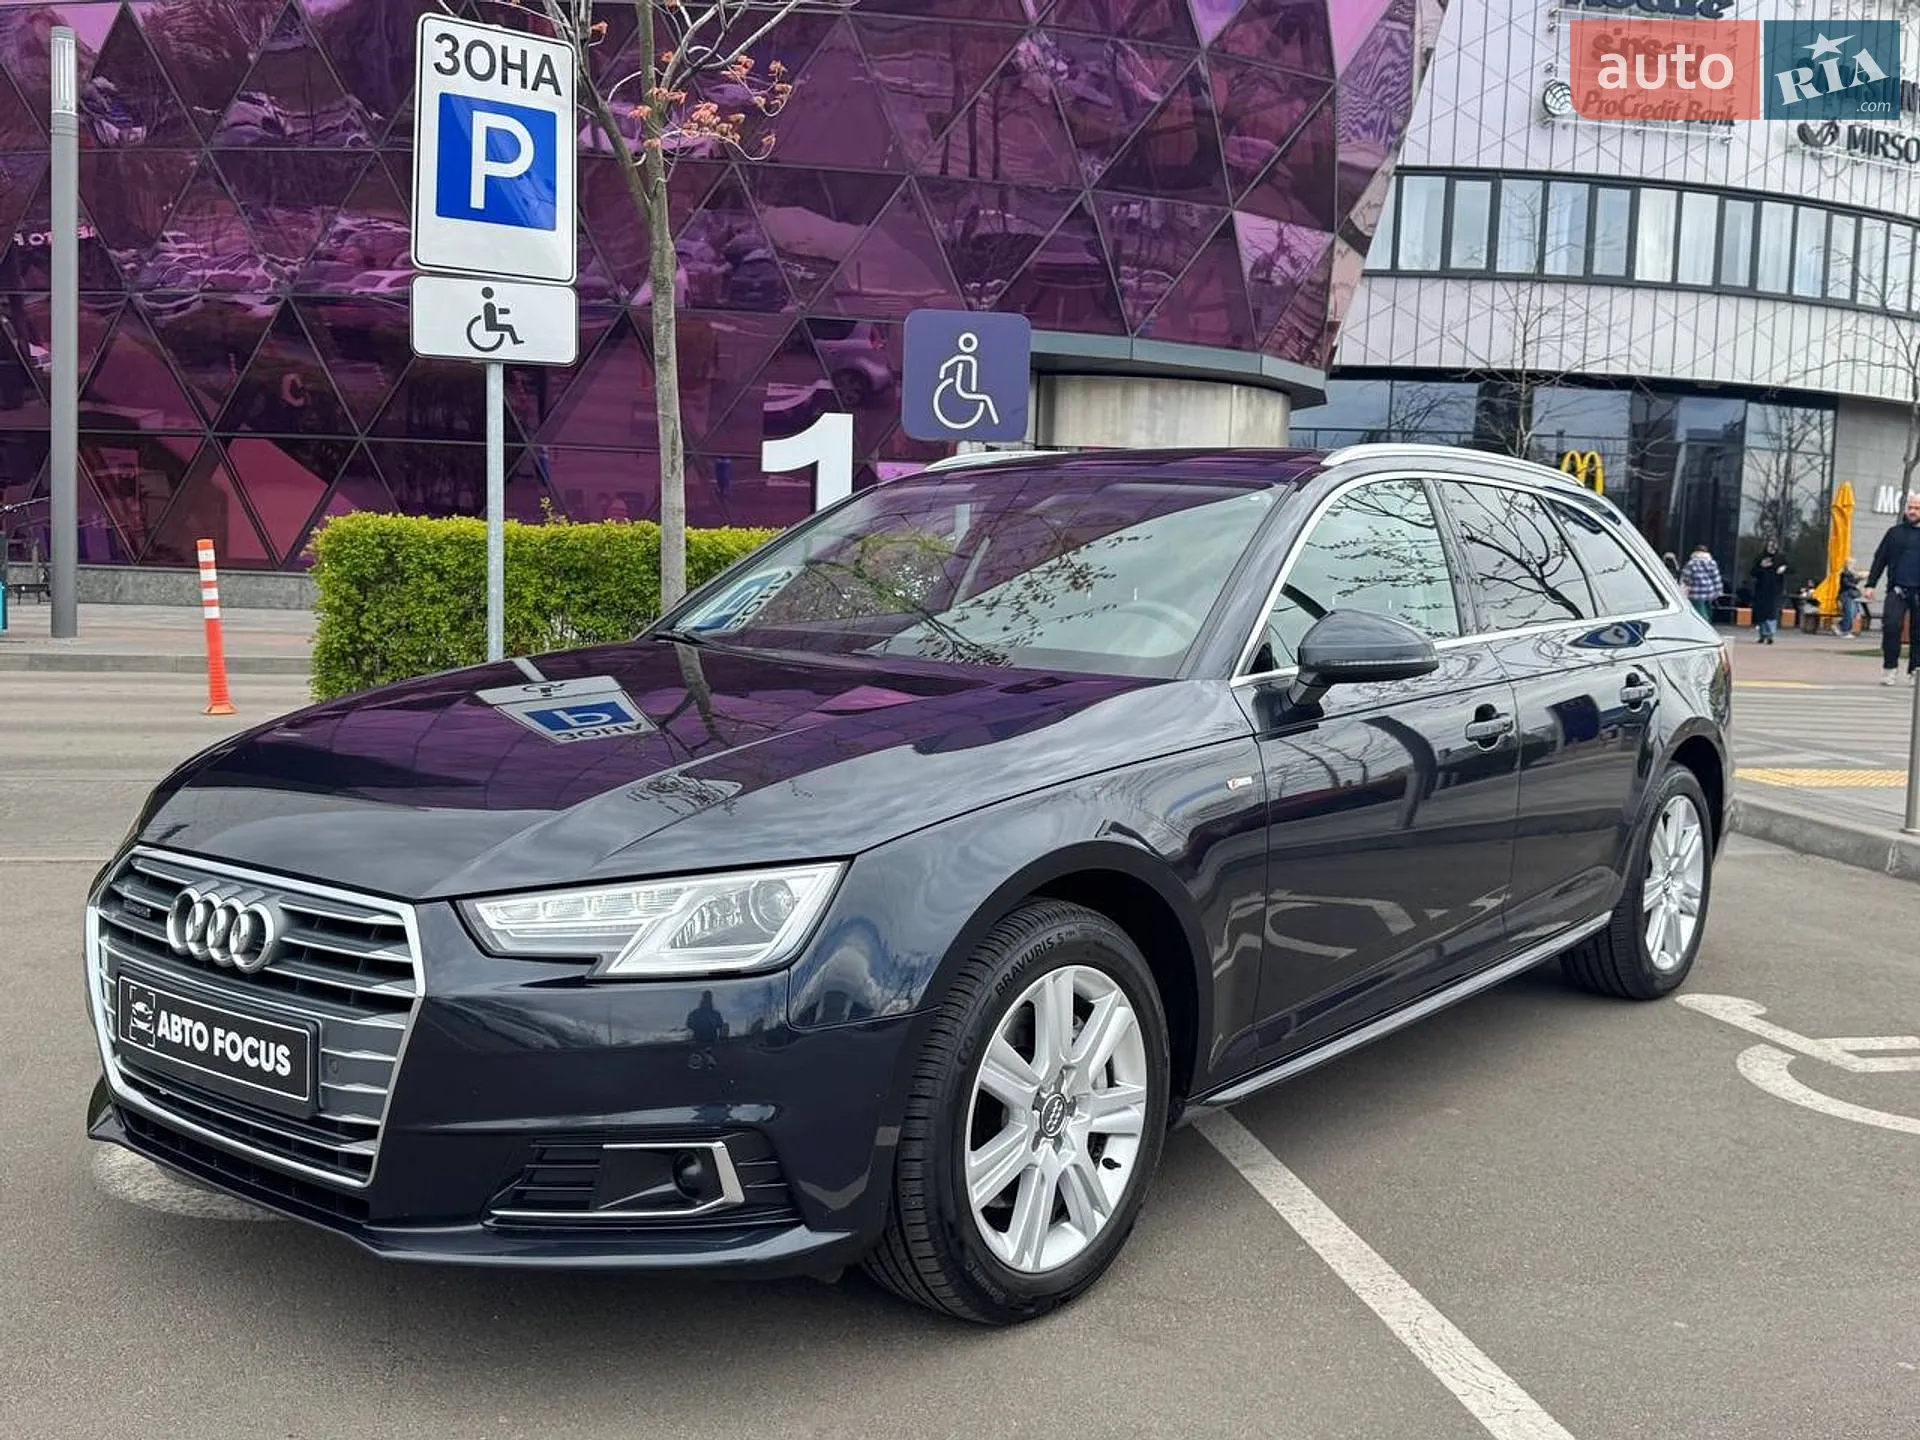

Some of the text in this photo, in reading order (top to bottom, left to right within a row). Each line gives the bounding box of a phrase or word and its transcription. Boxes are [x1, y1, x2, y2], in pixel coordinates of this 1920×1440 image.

[434, 33, 562, 96] ЗОНА
[1581, 90, 1738, 126] ProCredit Bank
[470, 110, 534, 210] P
[762, 412, 853, 512] 1
[157, 1010, 291, 1077] АВТО FOCUS
